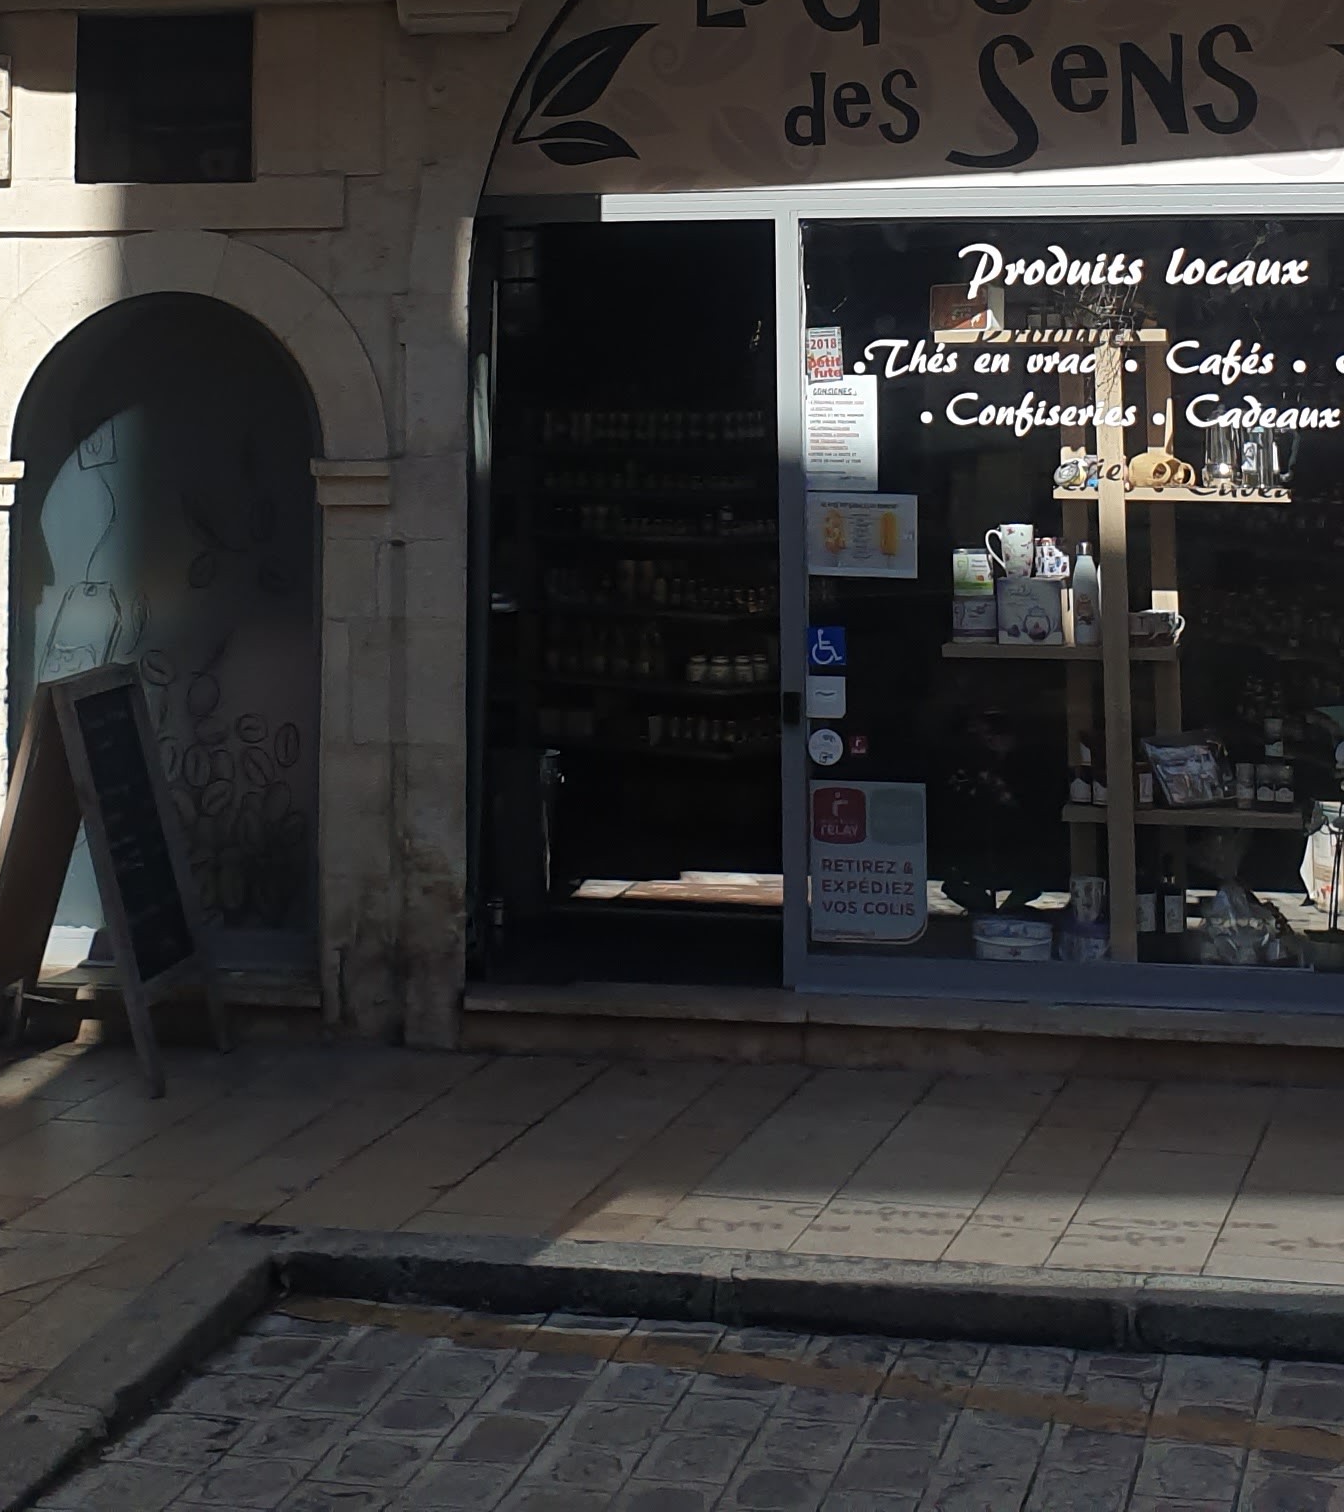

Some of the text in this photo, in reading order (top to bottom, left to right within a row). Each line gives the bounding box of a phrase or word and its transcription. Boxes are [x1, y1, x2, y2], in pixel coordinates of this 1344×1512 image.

[784, 68, 921, 146] des
[957, 242, 1311, 300] Produits locaux
[810, 337, 837, 350] 2018
[864, 338, 958, 379] Thés
[973, 351, 1010, 374] en
[1026, 351, 1100, 374] vrac
[1165, 338, 1277, 385] Cafés
[945, 391, 1341, 437] Confiseries Cadeaux
[821, 858, 897, 875] RETIREZ
[821, 876, 915, 896] EXPÉDIEZ
[821, 900, 916, 916] VOS COLIS
